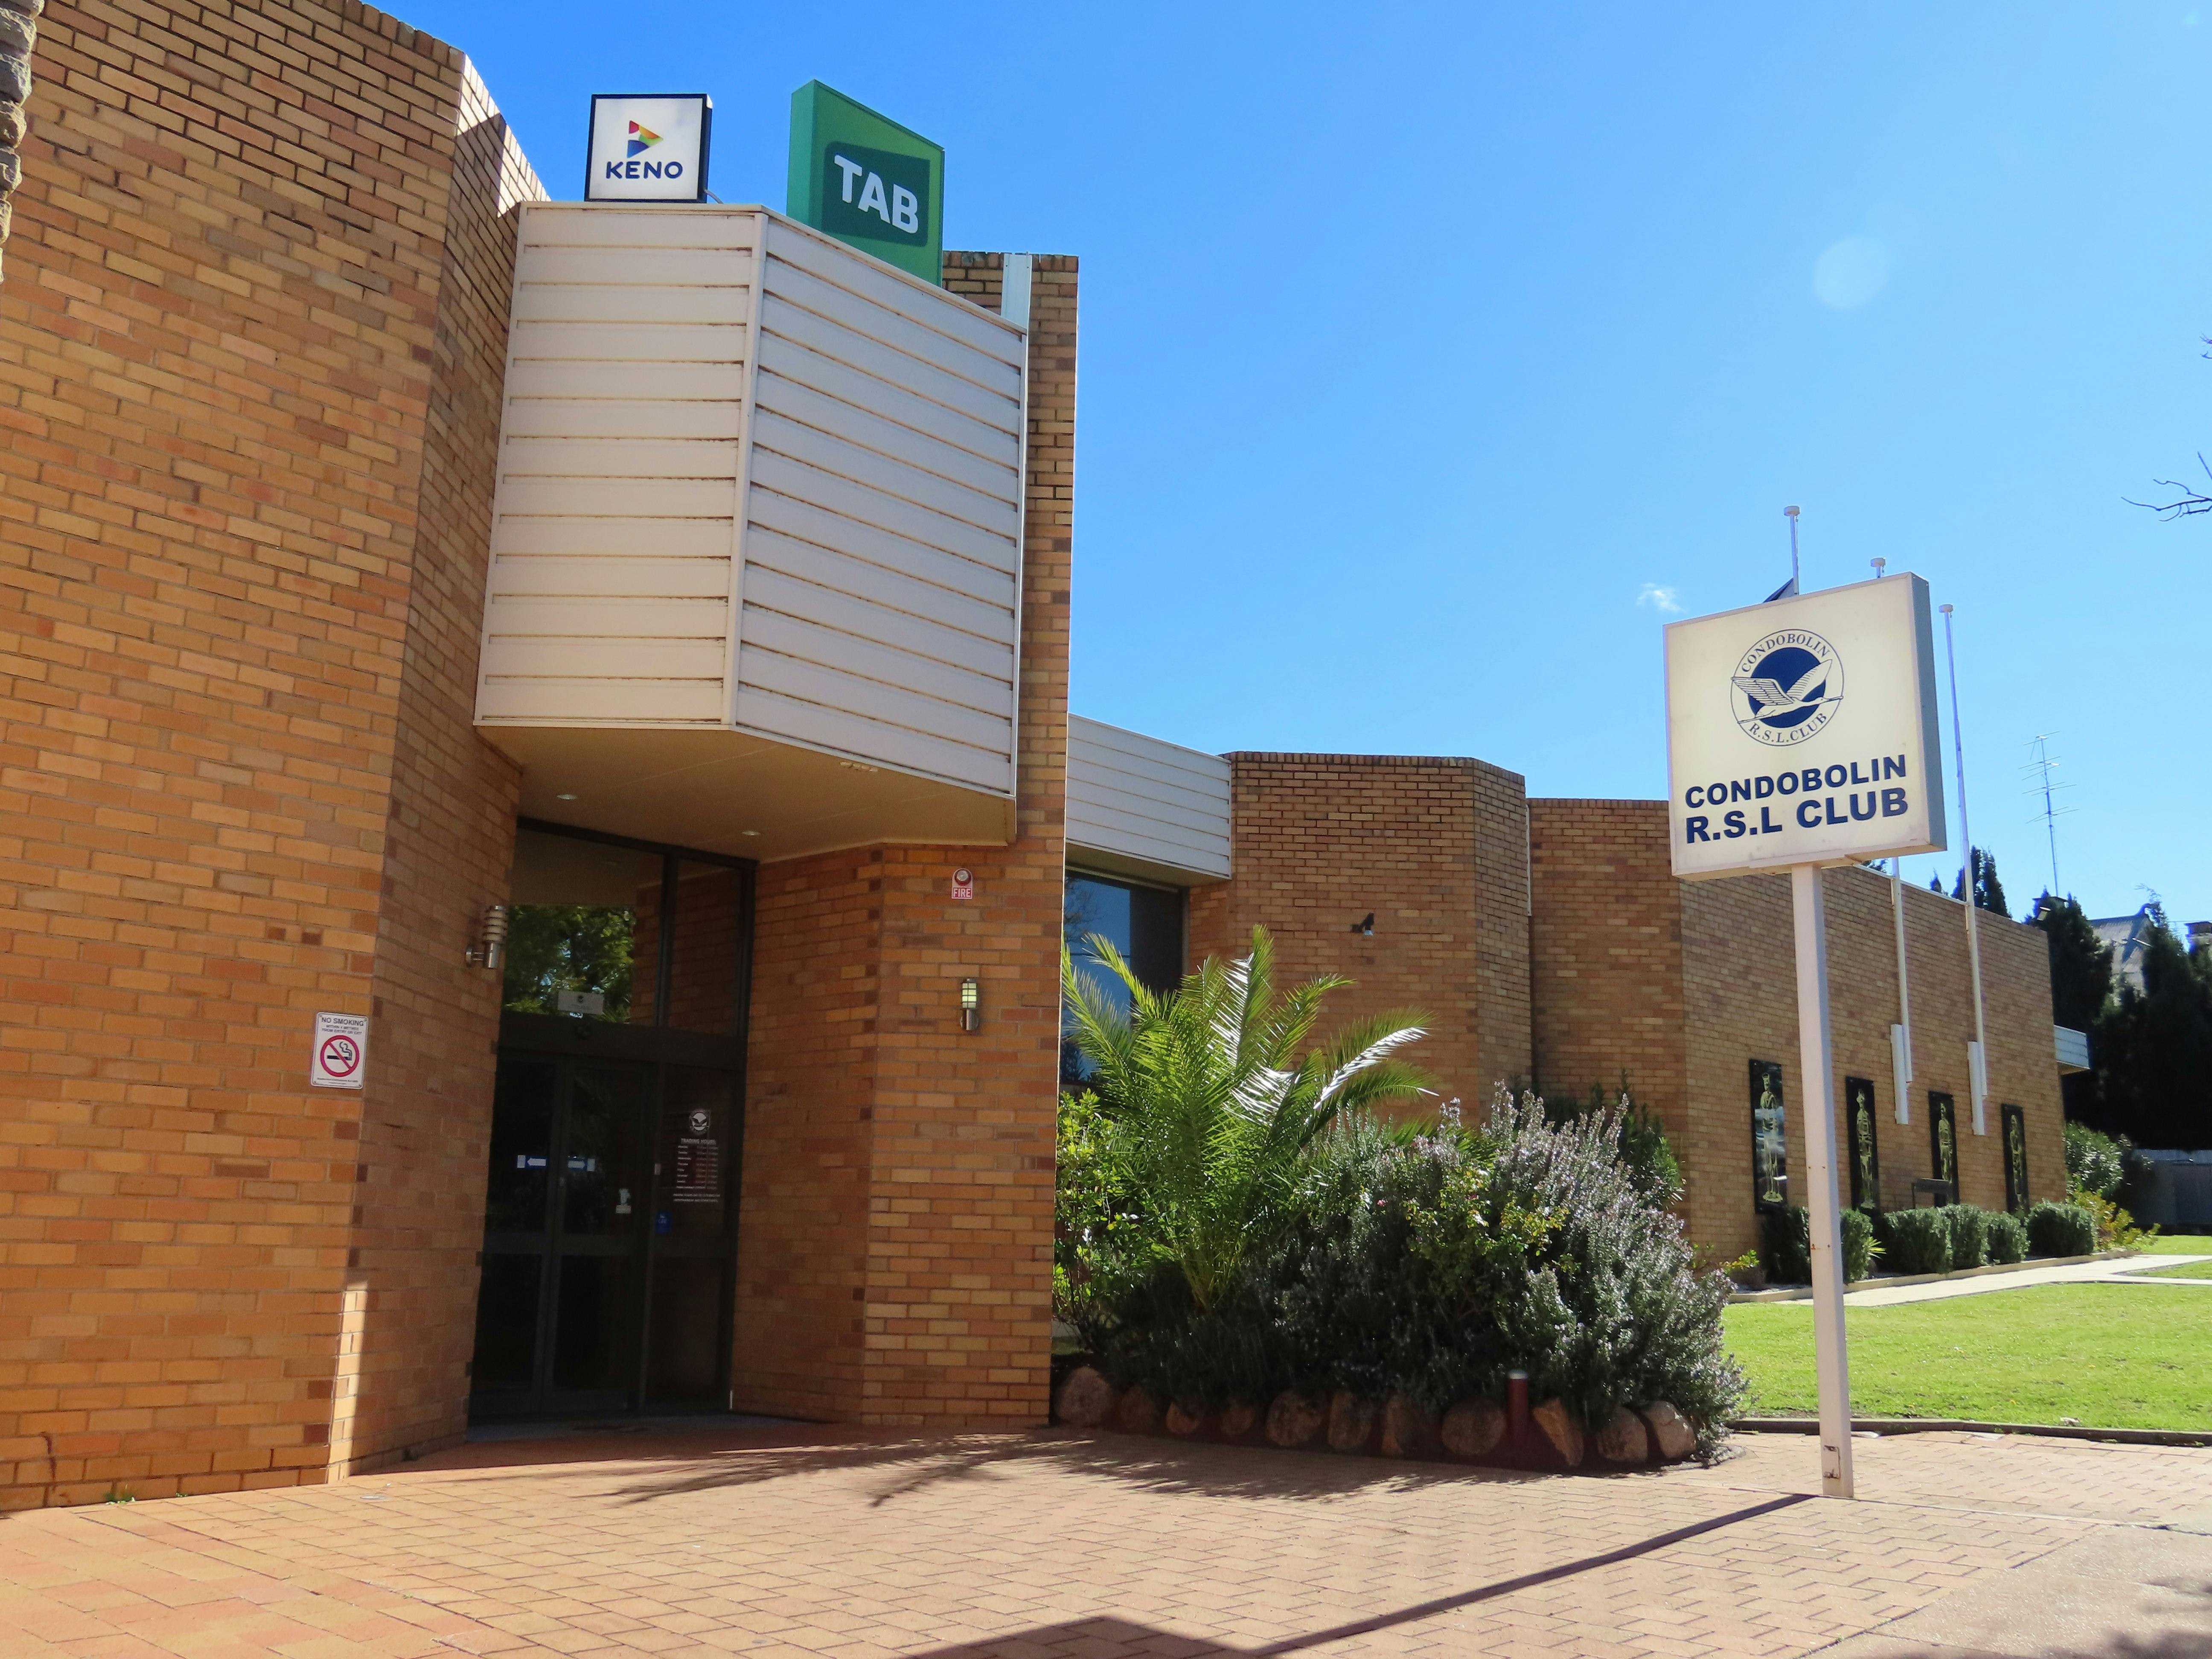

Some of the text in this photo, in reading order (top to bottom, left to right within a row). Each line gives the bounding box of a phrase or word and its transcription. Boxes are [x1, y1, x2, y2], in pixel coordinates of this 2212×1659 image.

[605, 161, 683, 179] KENO
[834, 155, 919, 234] TAB
[1741, 633, 1831, 672] CONDOBOLIN
[1685, 754, 1906, 808] CONDOBOLIN
[1686, 787, 1908, 844] R.S.L CLUB
[953, 888, 971, 897] FIRE
[333, 1018, 364, 1026] SMOKING
